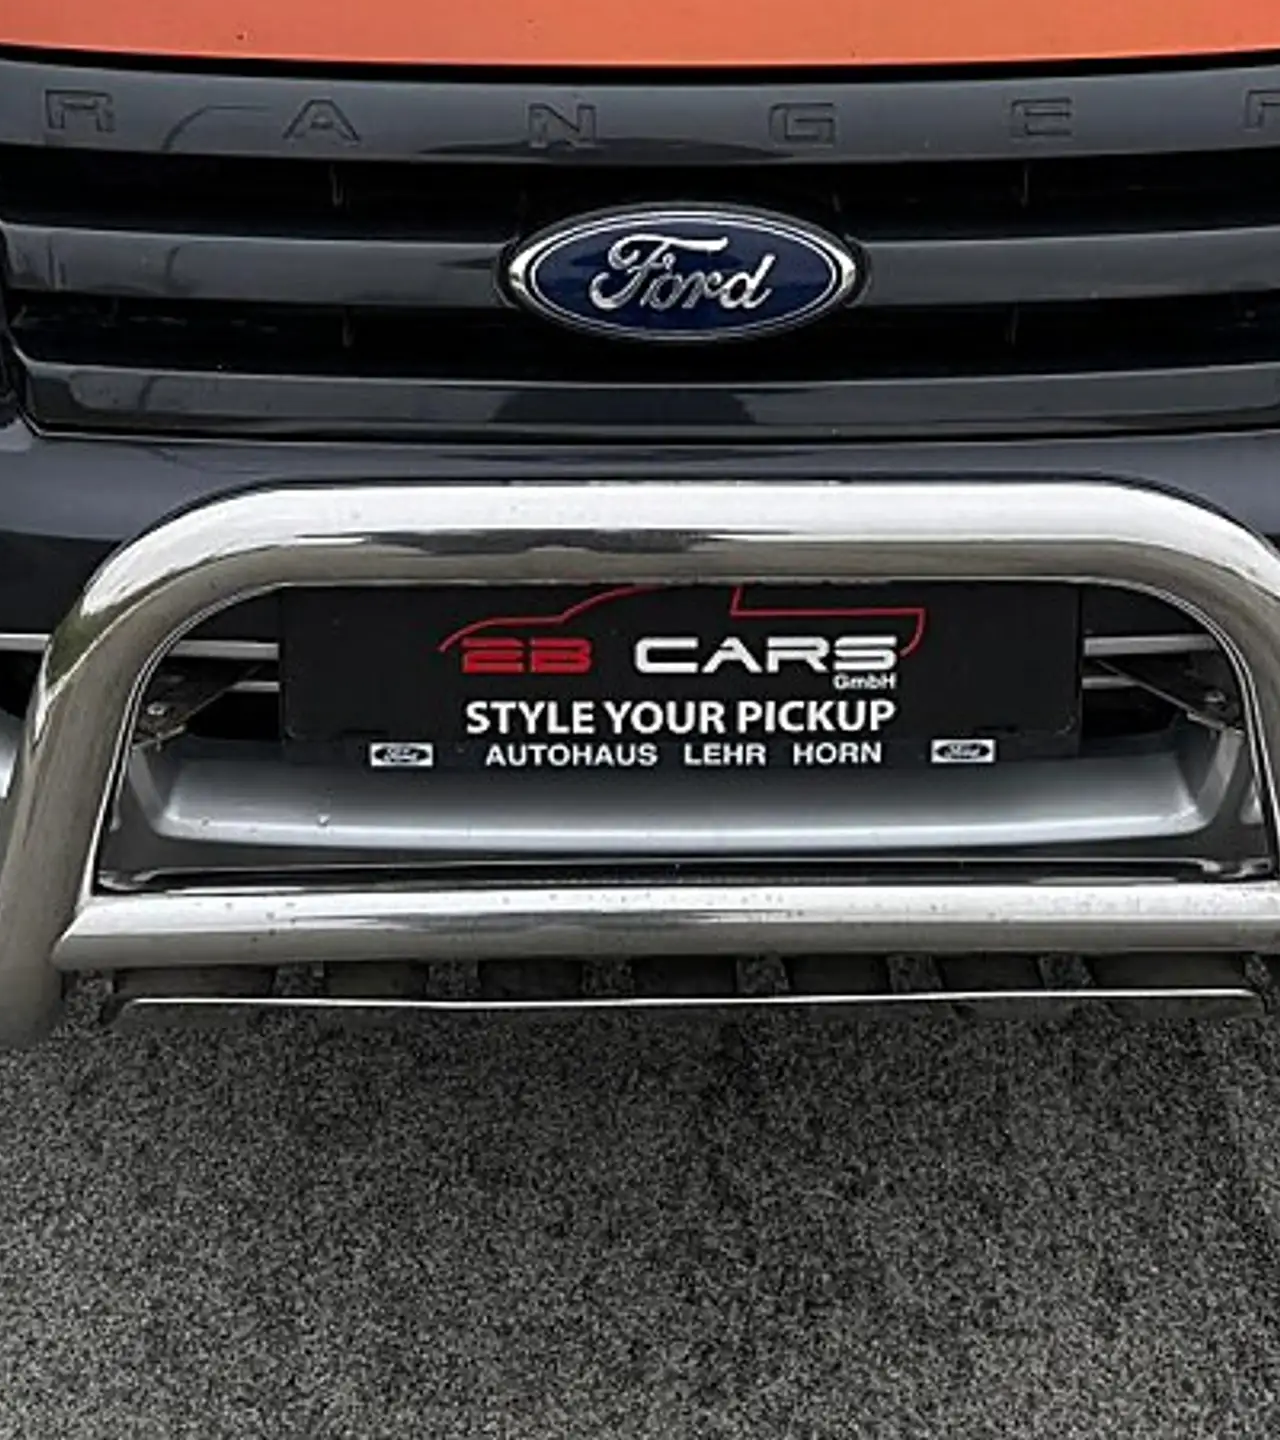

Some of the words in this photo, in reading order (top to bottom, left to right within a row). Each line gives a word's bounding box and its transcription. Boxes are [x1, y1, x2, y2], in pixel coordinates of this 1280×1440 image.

[588, 233, 776, 310] Ford
[633, 636, 898, 674] CARS
[833, 673, 897, 690] GmbH
[465, 699, 596, 735] STYLE
[603, 699, 726, 735] YOUR
[737, 698, 896, 734] PICKUP
[485, 741, 659, 767] AUTOHAUS
[683, 741, 767, 767] LEHR
[793, 740, 882, 766] HORN
